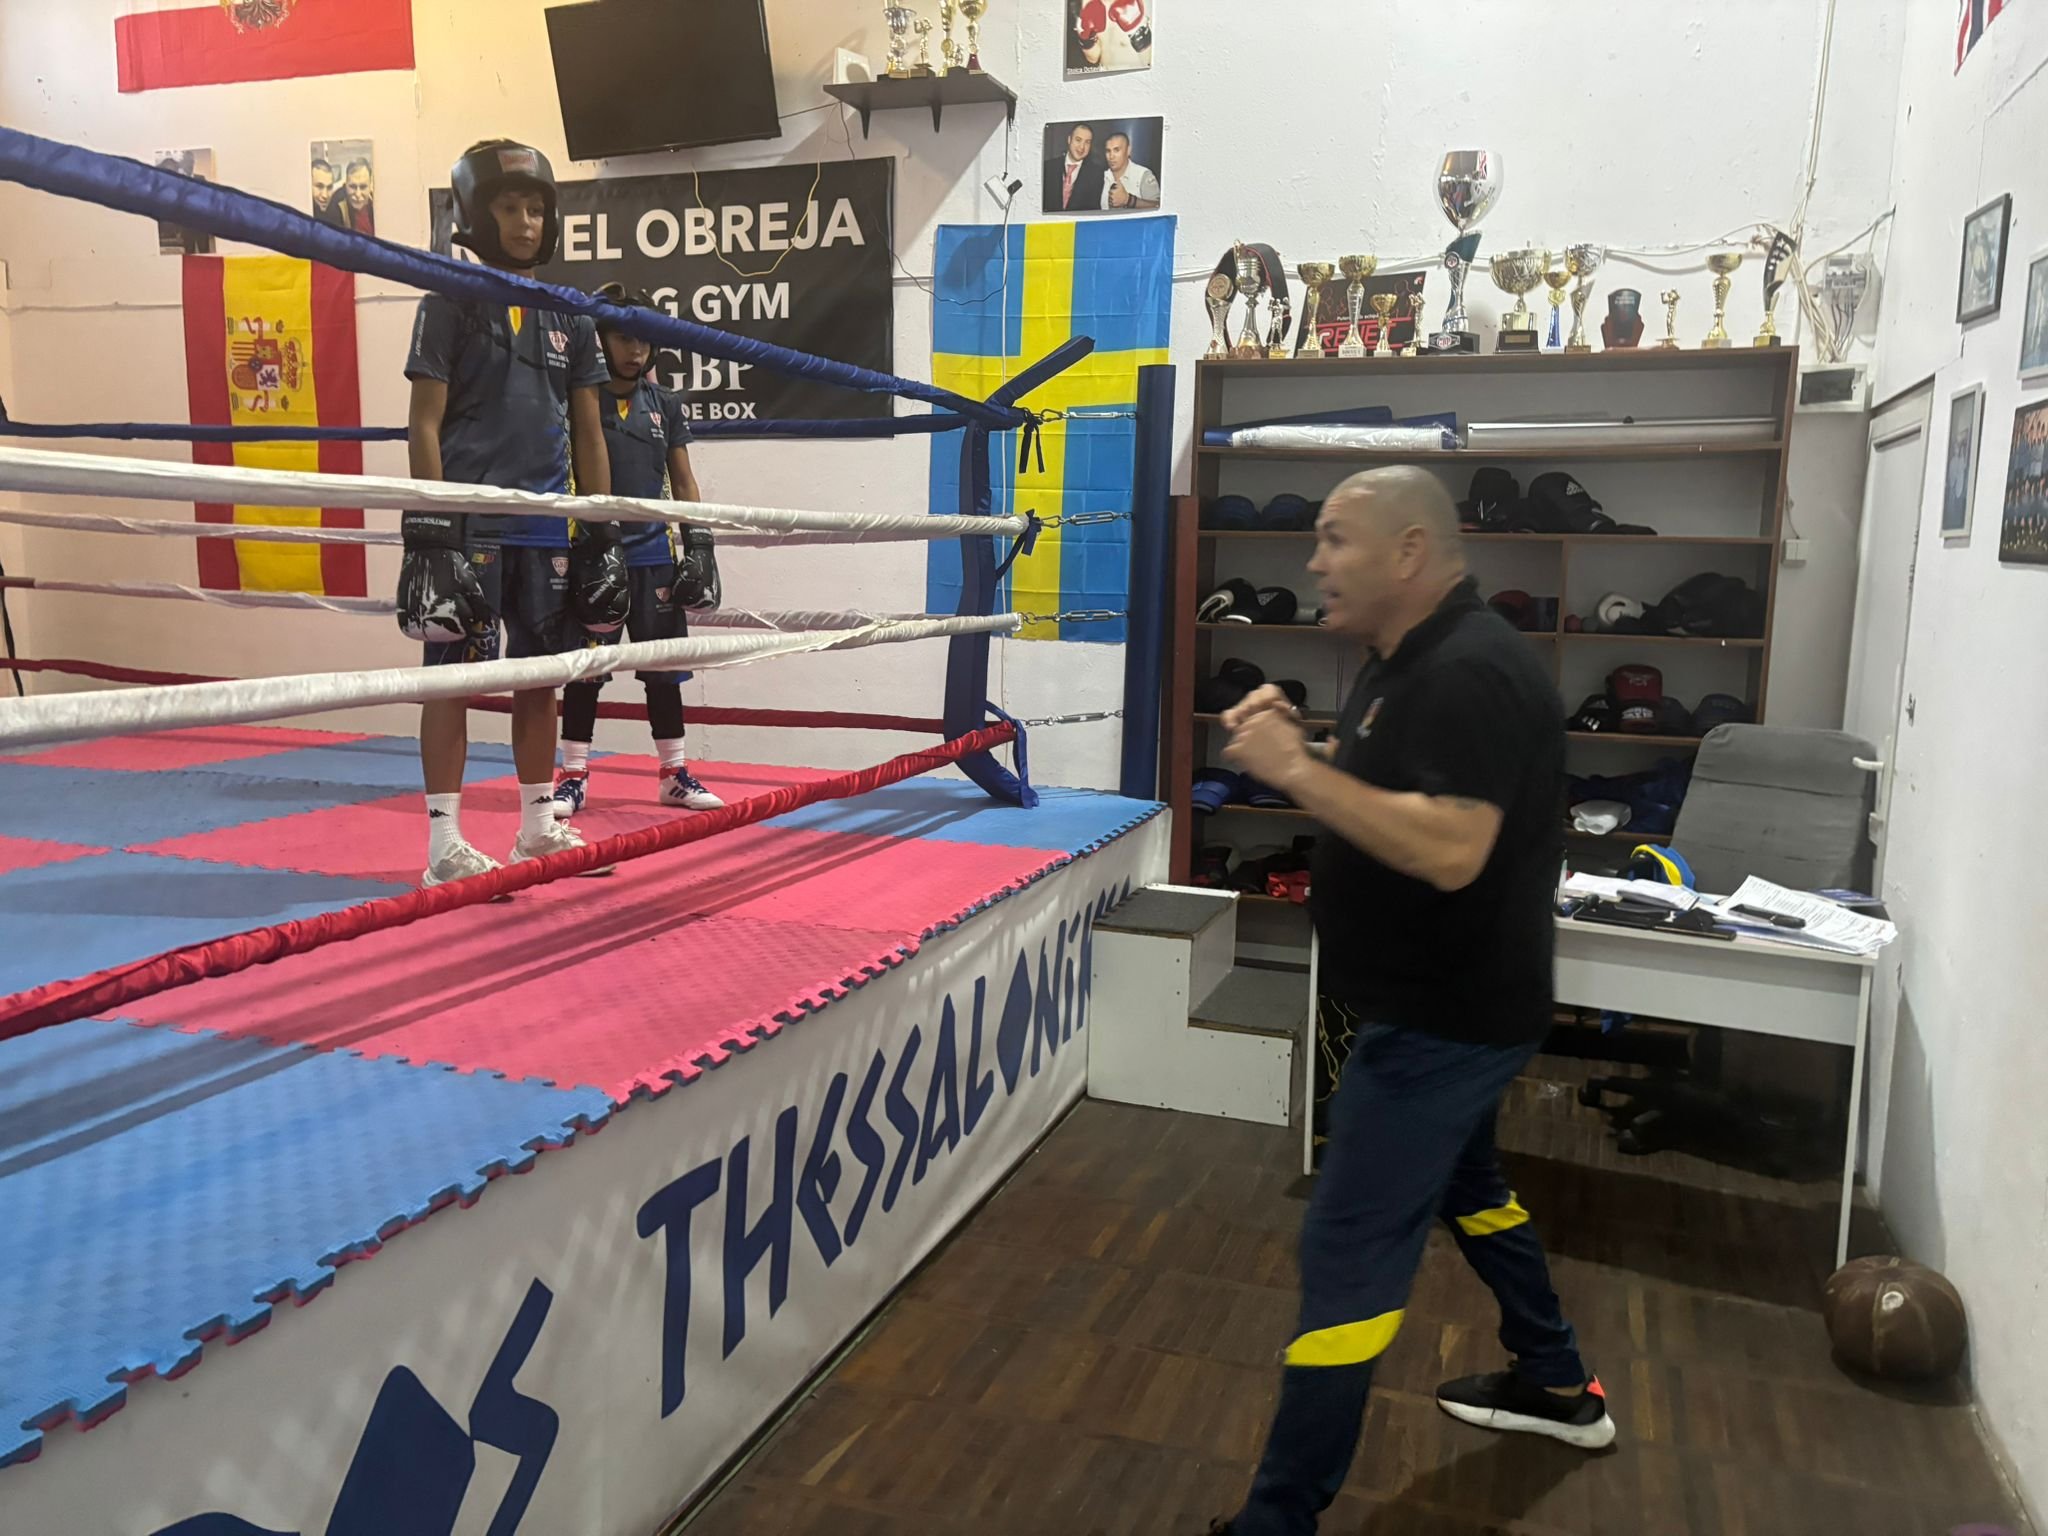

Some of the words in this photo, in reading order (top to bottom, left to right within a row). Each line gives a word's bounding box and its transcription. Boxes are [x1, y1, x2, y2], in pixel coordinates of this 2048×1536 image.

[636, 198, 865, 259] OBREJA
[692, 281, 790, 323] GYM
[709, 401, 757, 420] BOX
